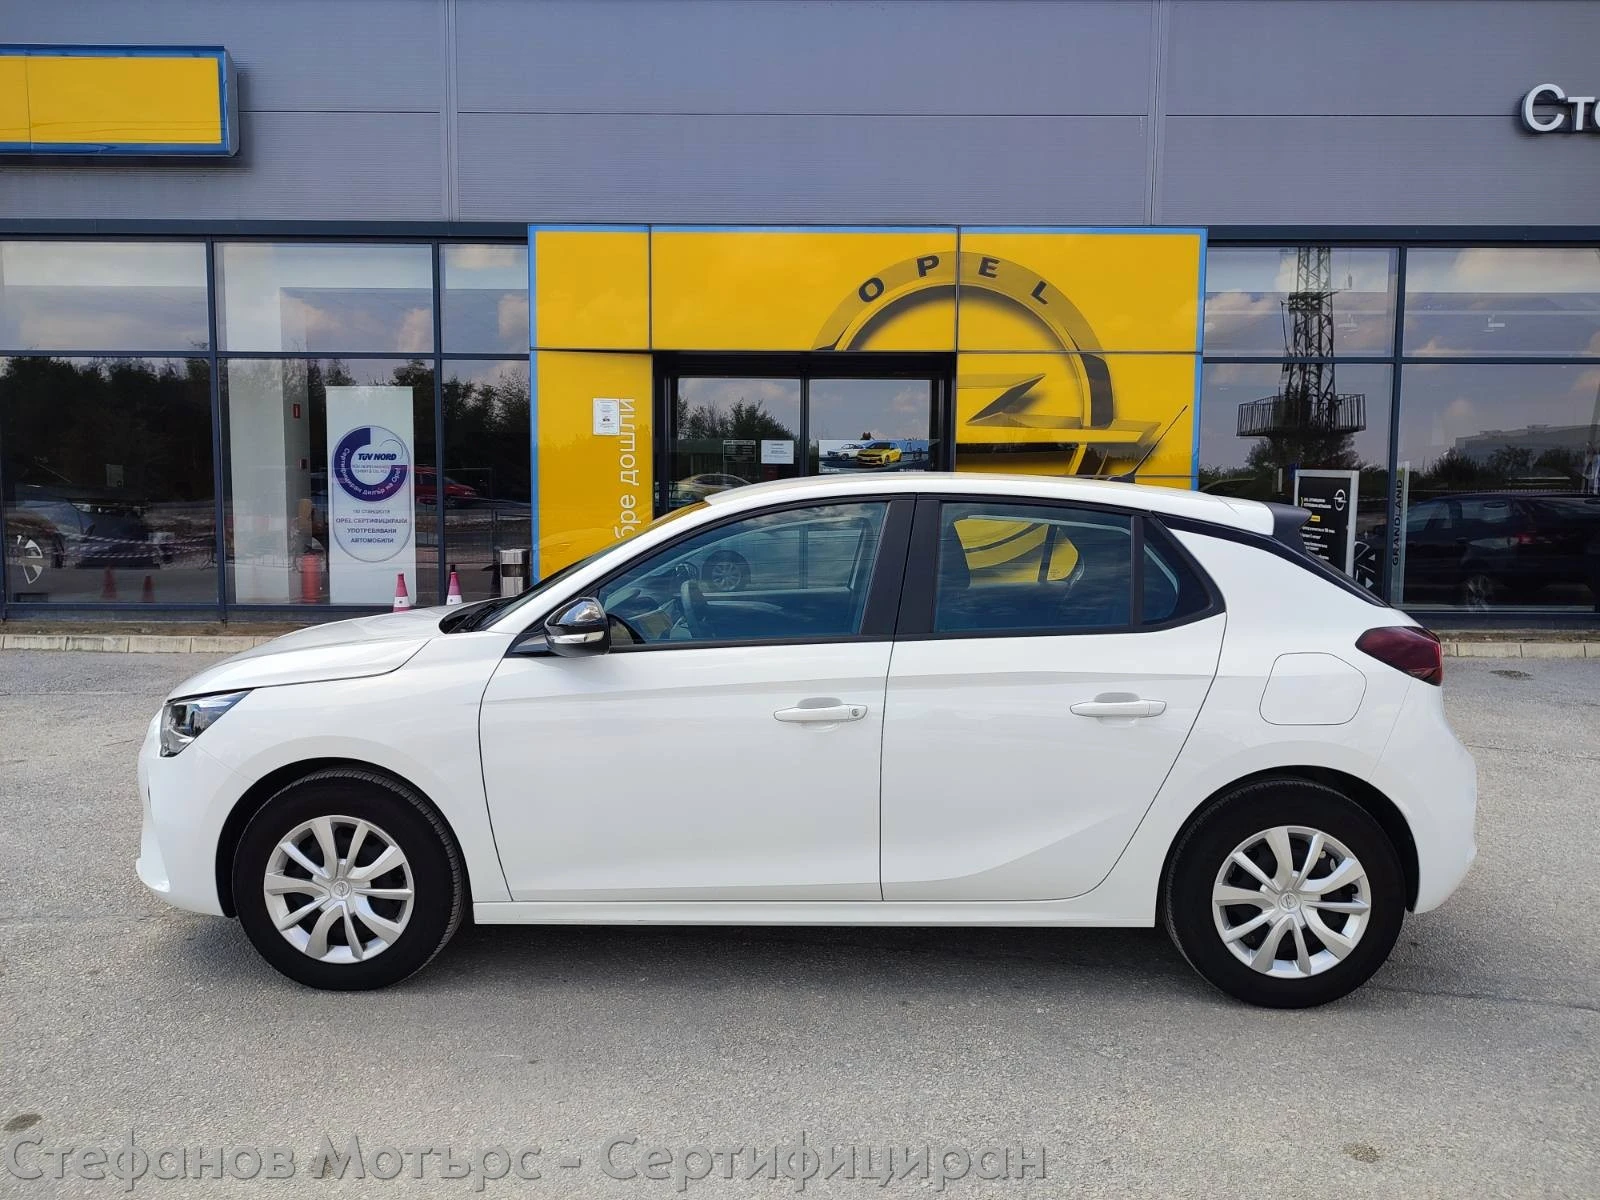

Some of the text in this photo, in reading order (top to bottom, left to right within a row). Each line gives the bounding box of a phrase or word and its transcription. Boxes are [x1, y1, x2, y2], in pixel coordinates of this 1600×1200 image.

[1523, 83, 1600, 132] Ст
[858, 253, 1049, 305] OPEL
[373, 453, 397, 461] NORD
[614, 398, 642, 539] бре дошли
[1392, 479, 1403, 566] GRANDLAND
